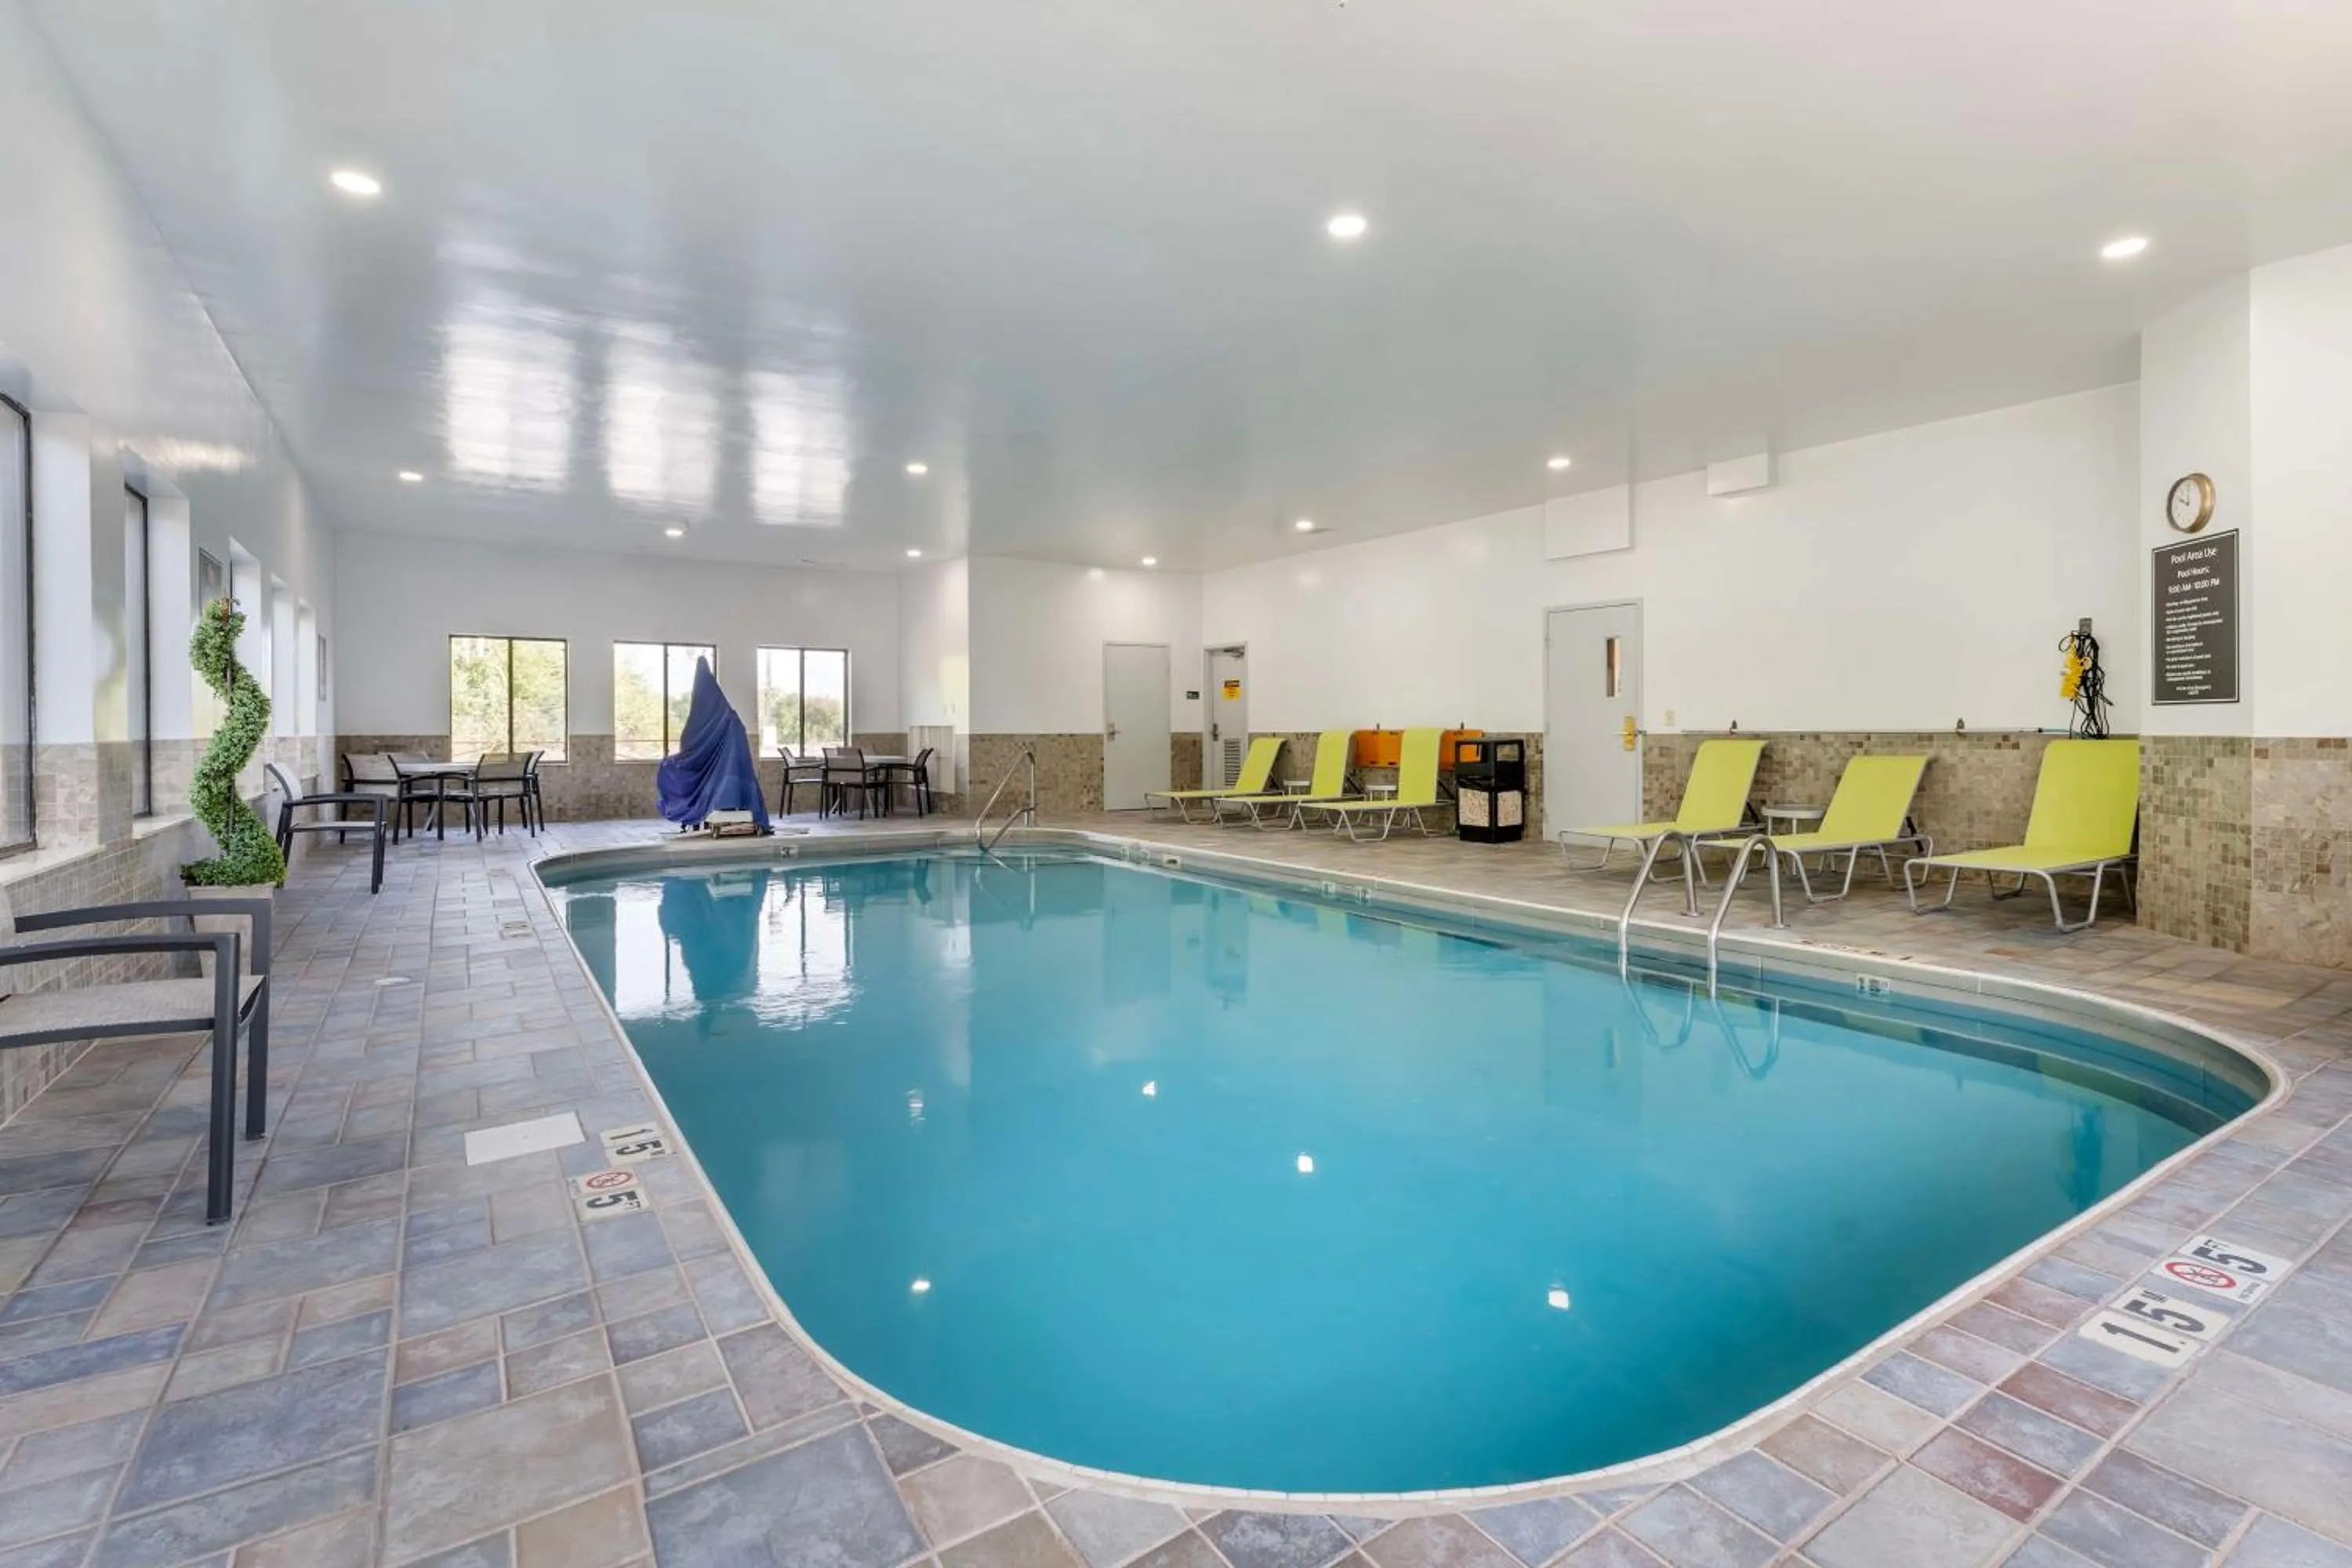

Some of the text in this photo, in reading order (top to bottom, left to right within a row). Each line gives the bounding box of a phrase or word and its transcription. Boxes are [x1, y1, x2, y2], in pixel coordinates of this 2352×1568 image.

[2171, 546, 2217, 564] Pool Area Use
[2177, 569, 2191, 579] Pool
[2181, 583, 2191, 592] AM
[2211, 578, 2220, 587] PM
